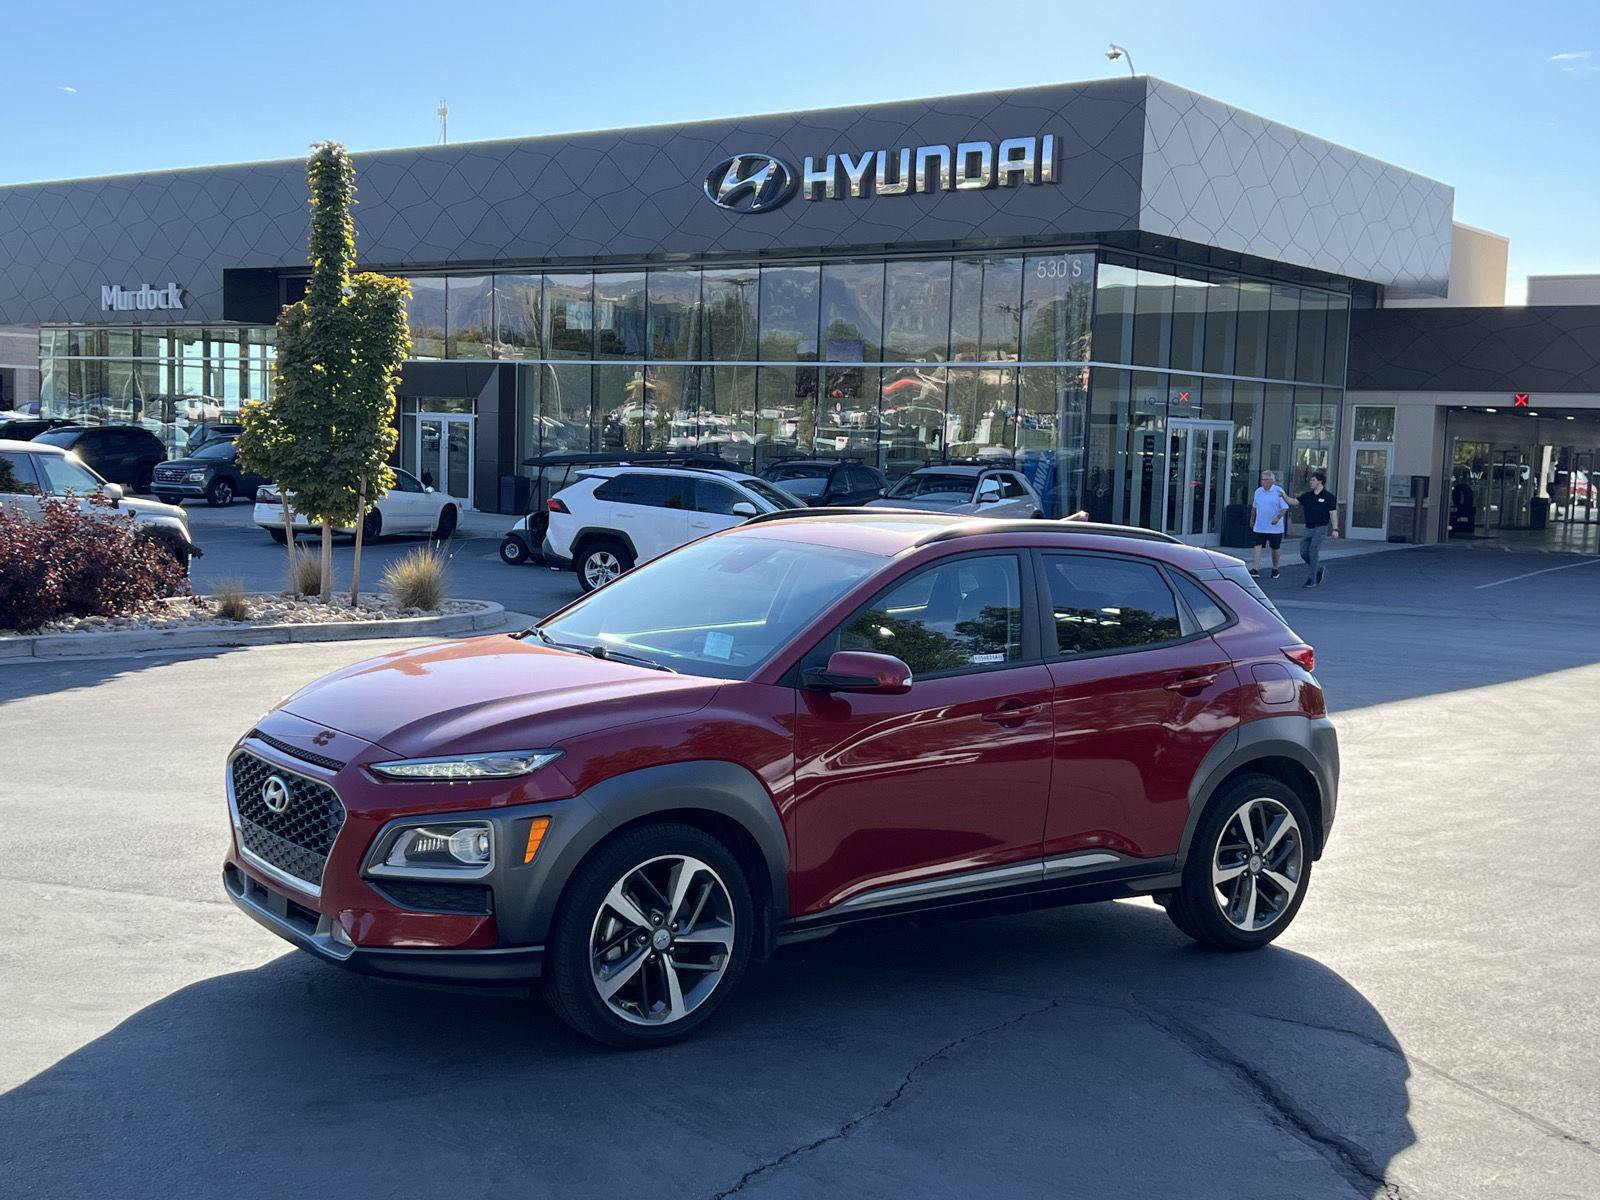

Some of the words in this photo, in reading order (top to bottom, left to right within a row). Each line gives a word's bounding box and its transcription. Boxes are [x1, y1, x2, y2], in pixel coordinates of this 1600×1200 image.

[803, 134, 1056, 201] HYUNDAI
[1037, 260, 1067, 278] 530
[1071, 259, 1082, 277] S
[101, 282, 184, 311] Murdock
